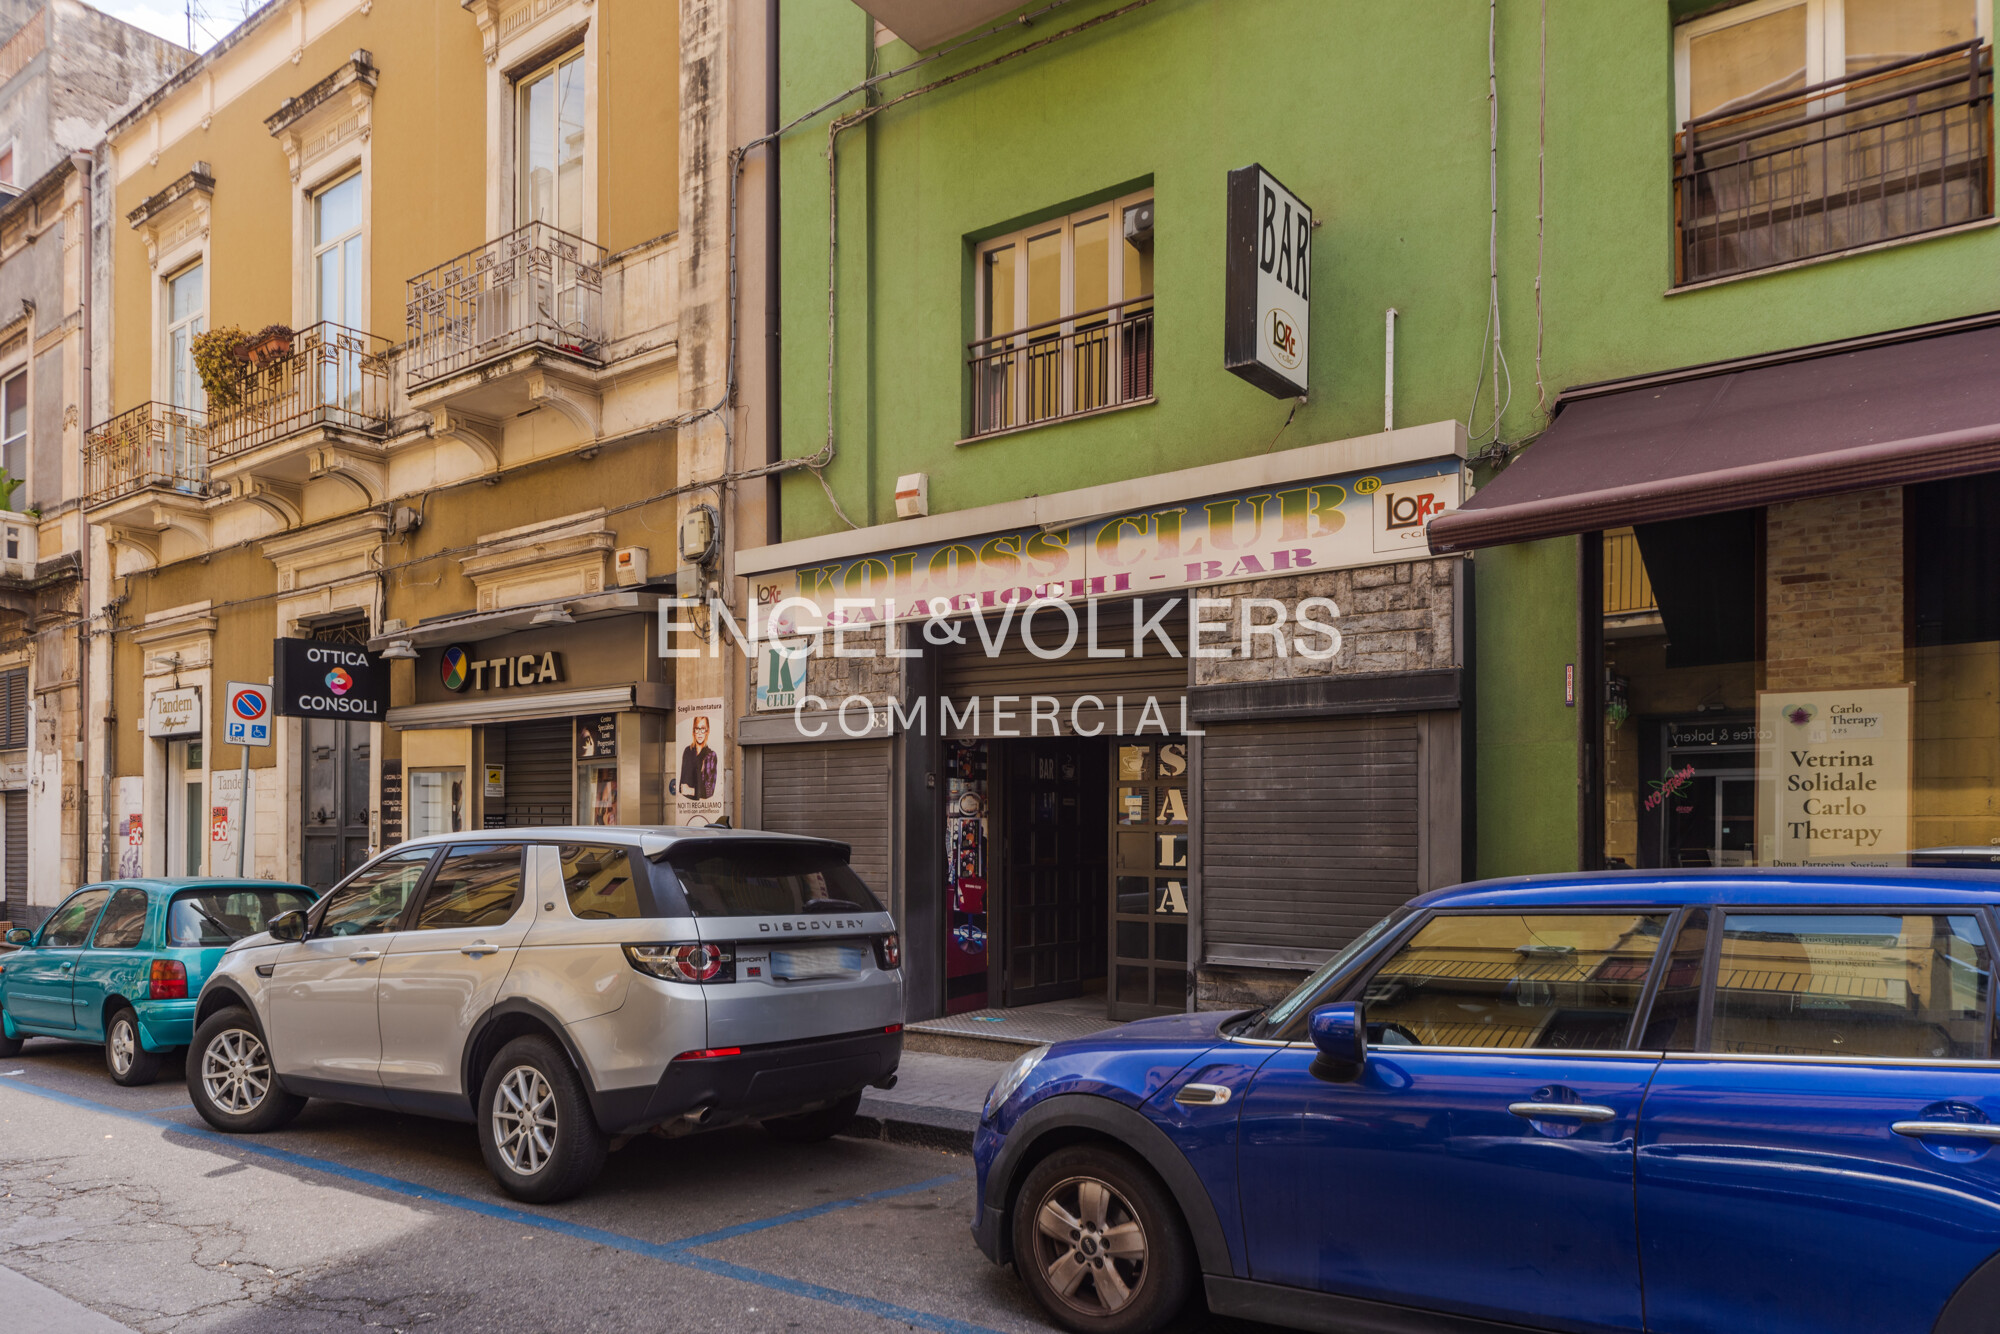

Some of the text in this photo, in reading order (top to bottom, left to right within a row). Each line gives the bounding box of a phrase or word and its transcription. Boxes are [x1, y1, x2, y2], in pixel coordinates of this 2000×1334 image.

[1260, 184, 1308, 301] BAR
[797, 528, 1070, 606] KOLOSS
[1095, 484, 1347, 567] CLUB
[1184, 548, 1317, 582] BAR
[307, 648, 369, 667] OTTICA
[766, 647, 796, 693] K
[156, 696, 193, 715] Tandem
[299, 695, 377, 714] CONSOLI
[766, 693, 795, 708] CLUB
[1830, 704, 1862, 715] Carlo
[872, 712, 888, 728] 83
[1830, 715, 1879, 727] Therapy
[232, 724, 243, 736] P
[1790, 751, 1875, 767] Vetrina
[1039, 758, 1054, 780] BAR
[1787, 772, 1877, 792] Solidale
[1803, 797, 1867, 816] Carlo
[1787, 821, 1883, 847] Therapy
[759, 919, 865, 932] DISCOVERY
